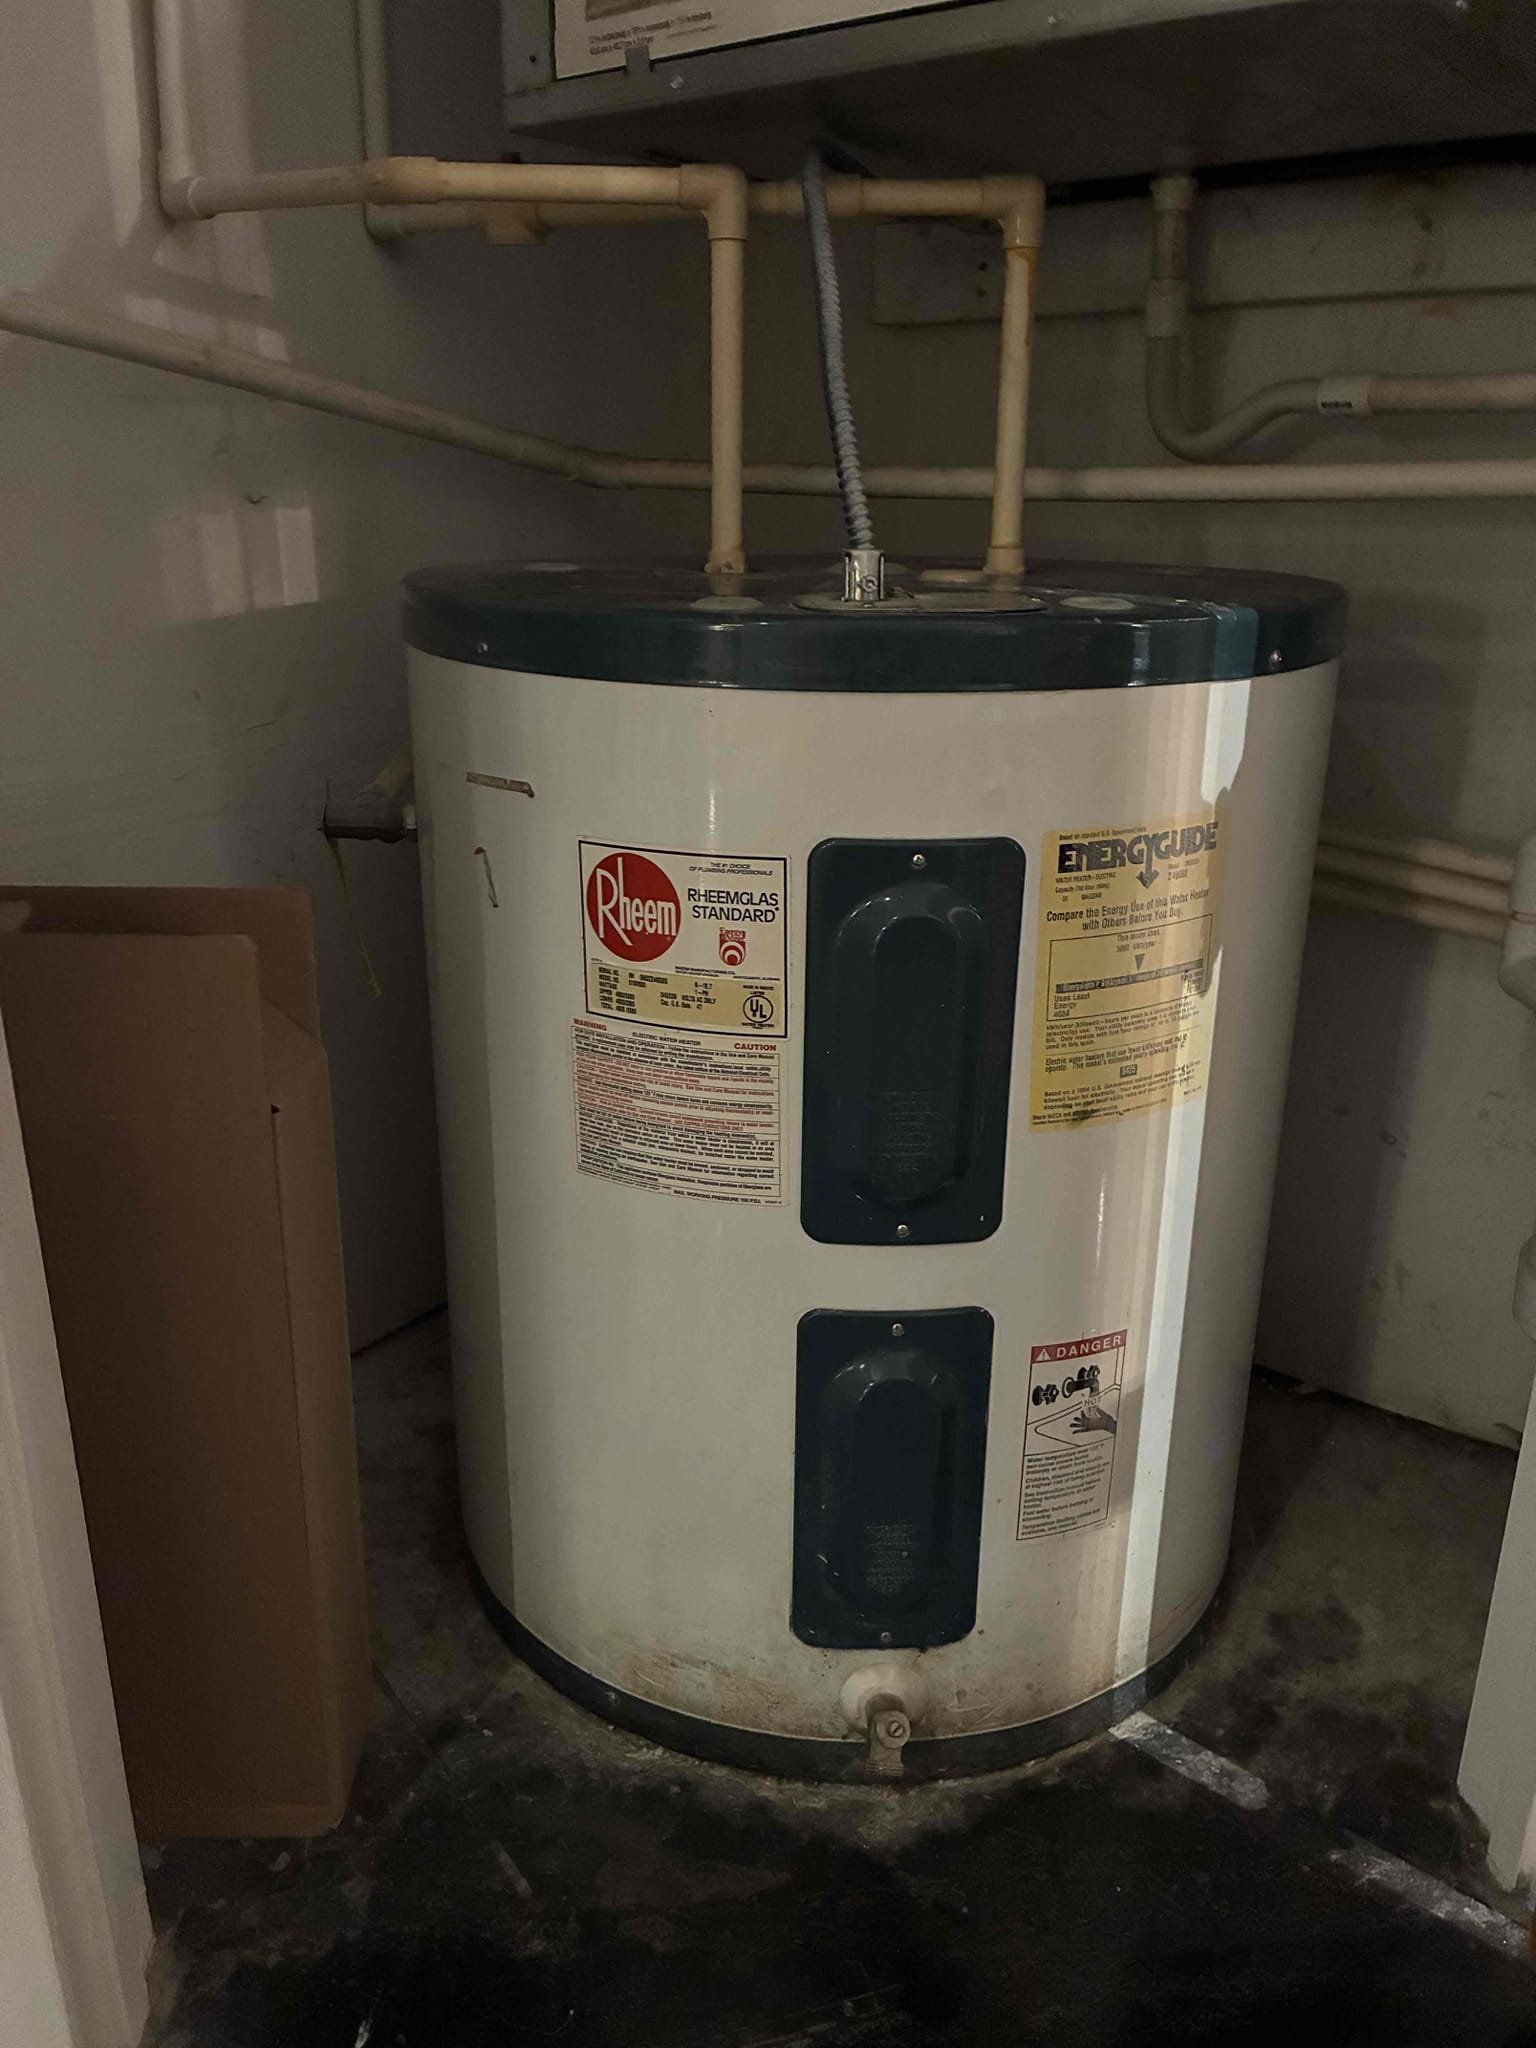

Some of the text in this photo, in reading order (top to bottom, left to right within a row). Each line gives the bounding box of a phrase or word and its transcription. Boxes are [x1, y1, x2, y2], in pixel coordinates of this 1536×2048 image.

[594, 856, 677, 946] Rheem
[688, 888, 779, 906] RHEEMGLAS
[1046, 888, 1209, 922] Compare the Energy Use of this Water Heater
[692, 905, 775, 922] STANDARD
[1082, 907, 1183, 930] with Others Before You Buy.
[1054, 992, 1090, 1002] Uses Least
[574, 1019, 607, 1031] WARNING
[632, 1032, 658, 1040] ELECTRIC
[1056, 1335, 1121, 1358] DANGER
[1084, 1397, 1101, 1407] HOT
